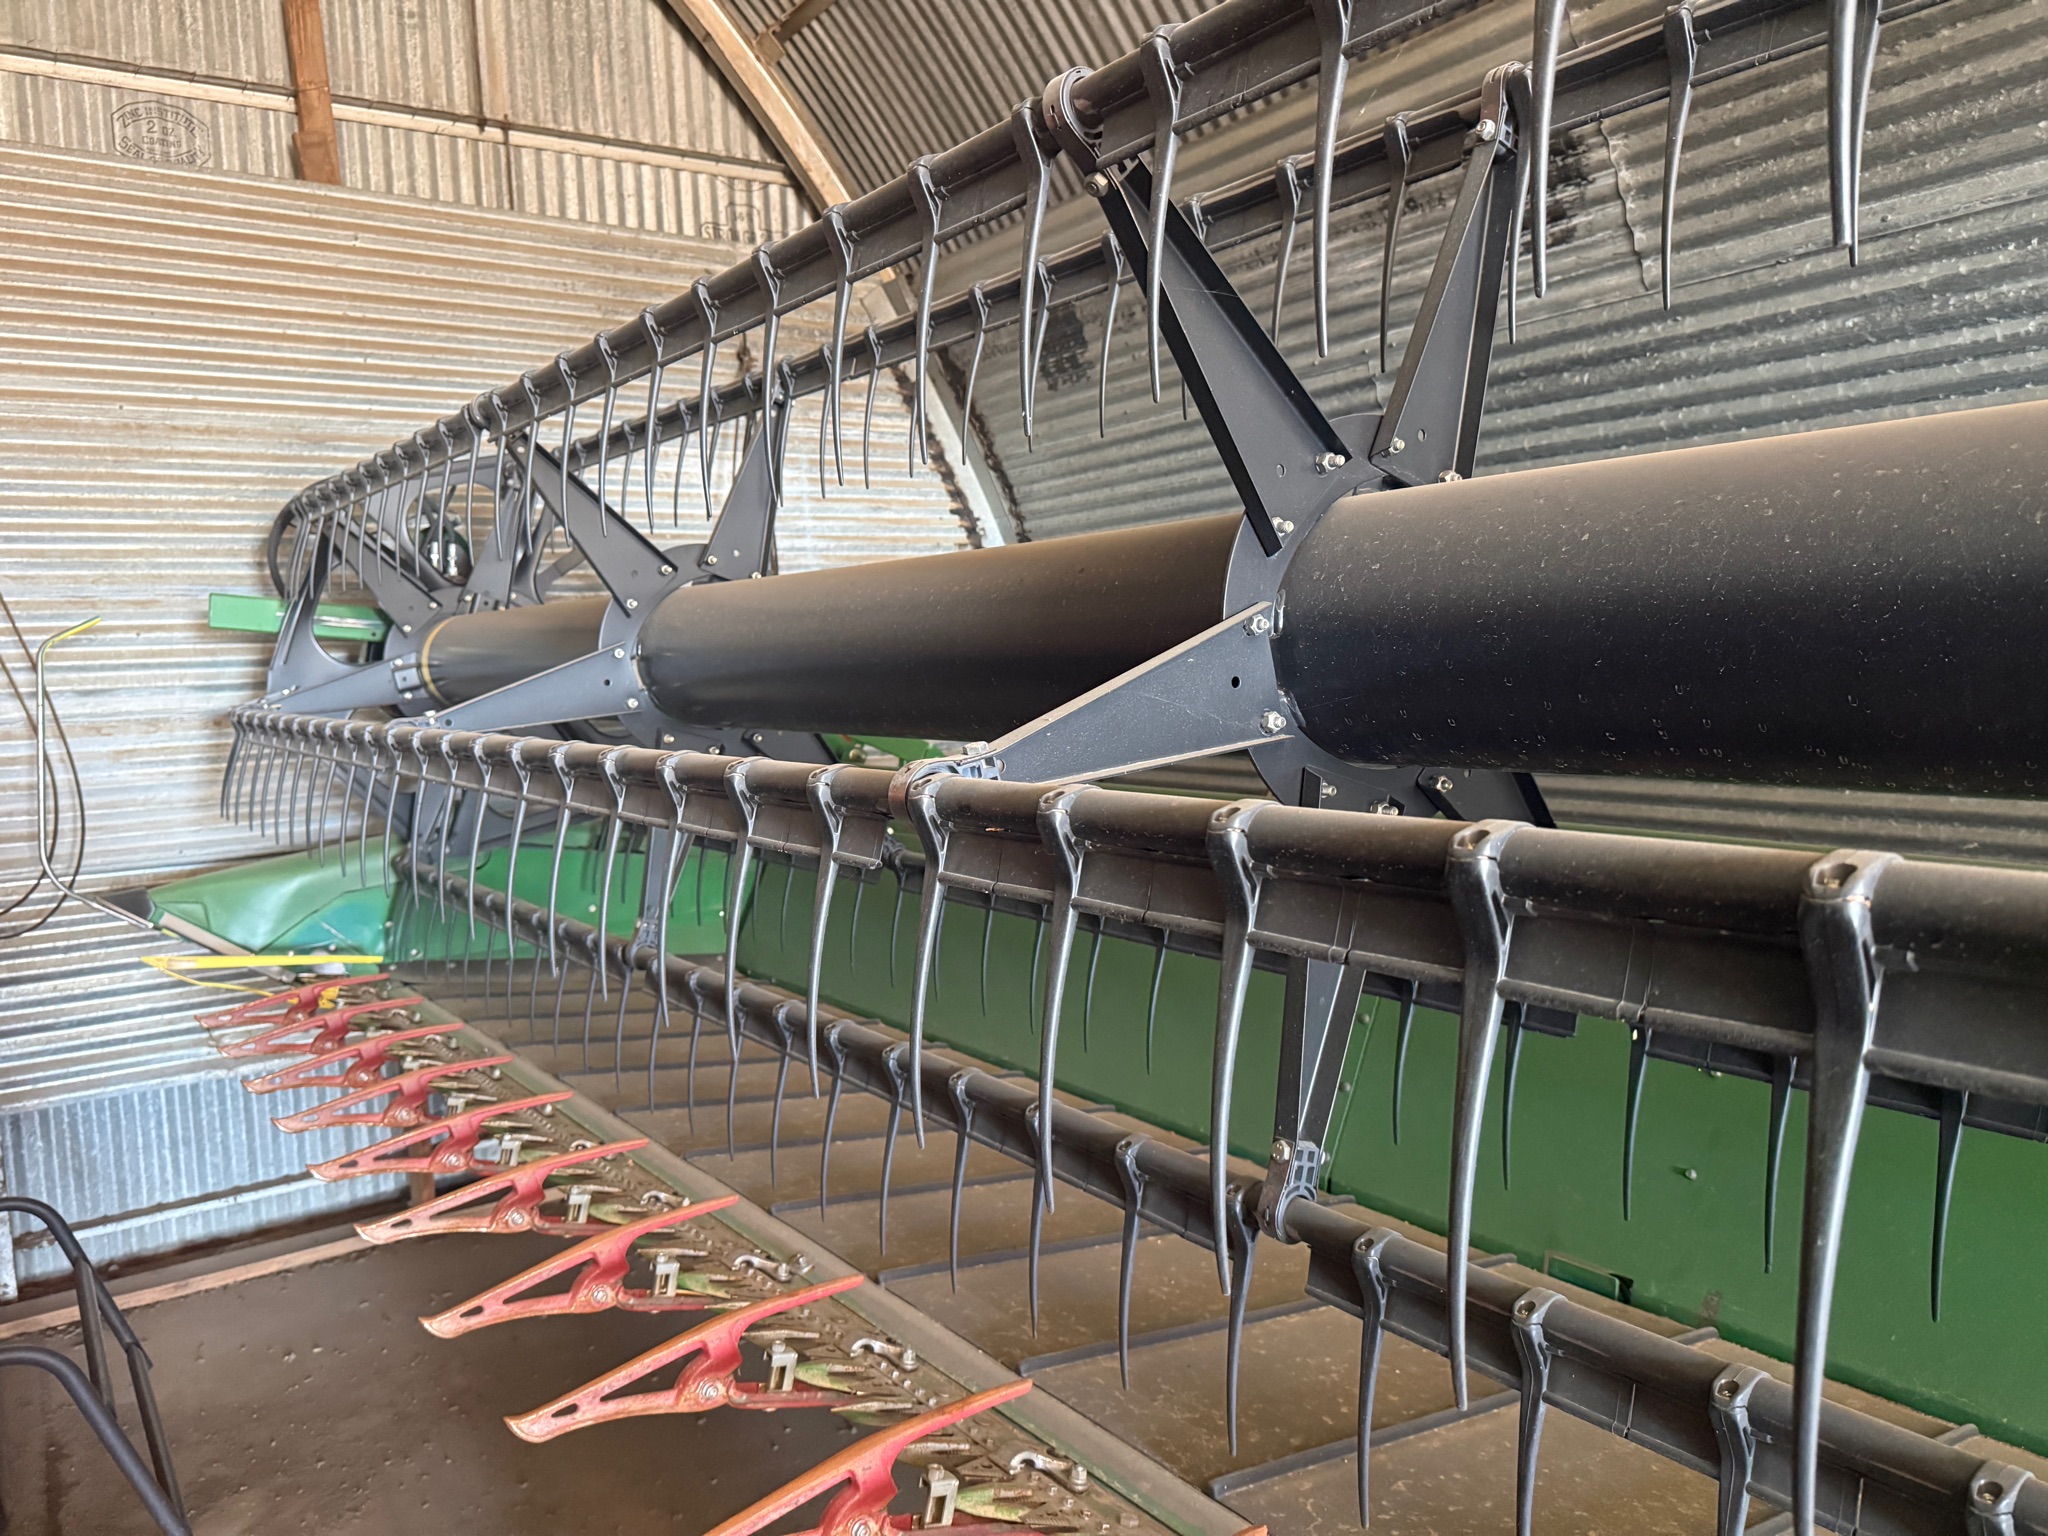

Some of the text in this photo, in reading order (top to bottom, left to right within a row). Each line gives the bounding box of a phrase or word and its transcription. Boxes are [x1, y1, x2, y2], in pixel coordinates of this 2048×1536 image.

[116, 106, 197, 139] ZINC INSTITUTE
[146, 119, 158, 134] 2
[118, 135, 144, 160] SEAL
[141, 135, 182, 149] COATING
